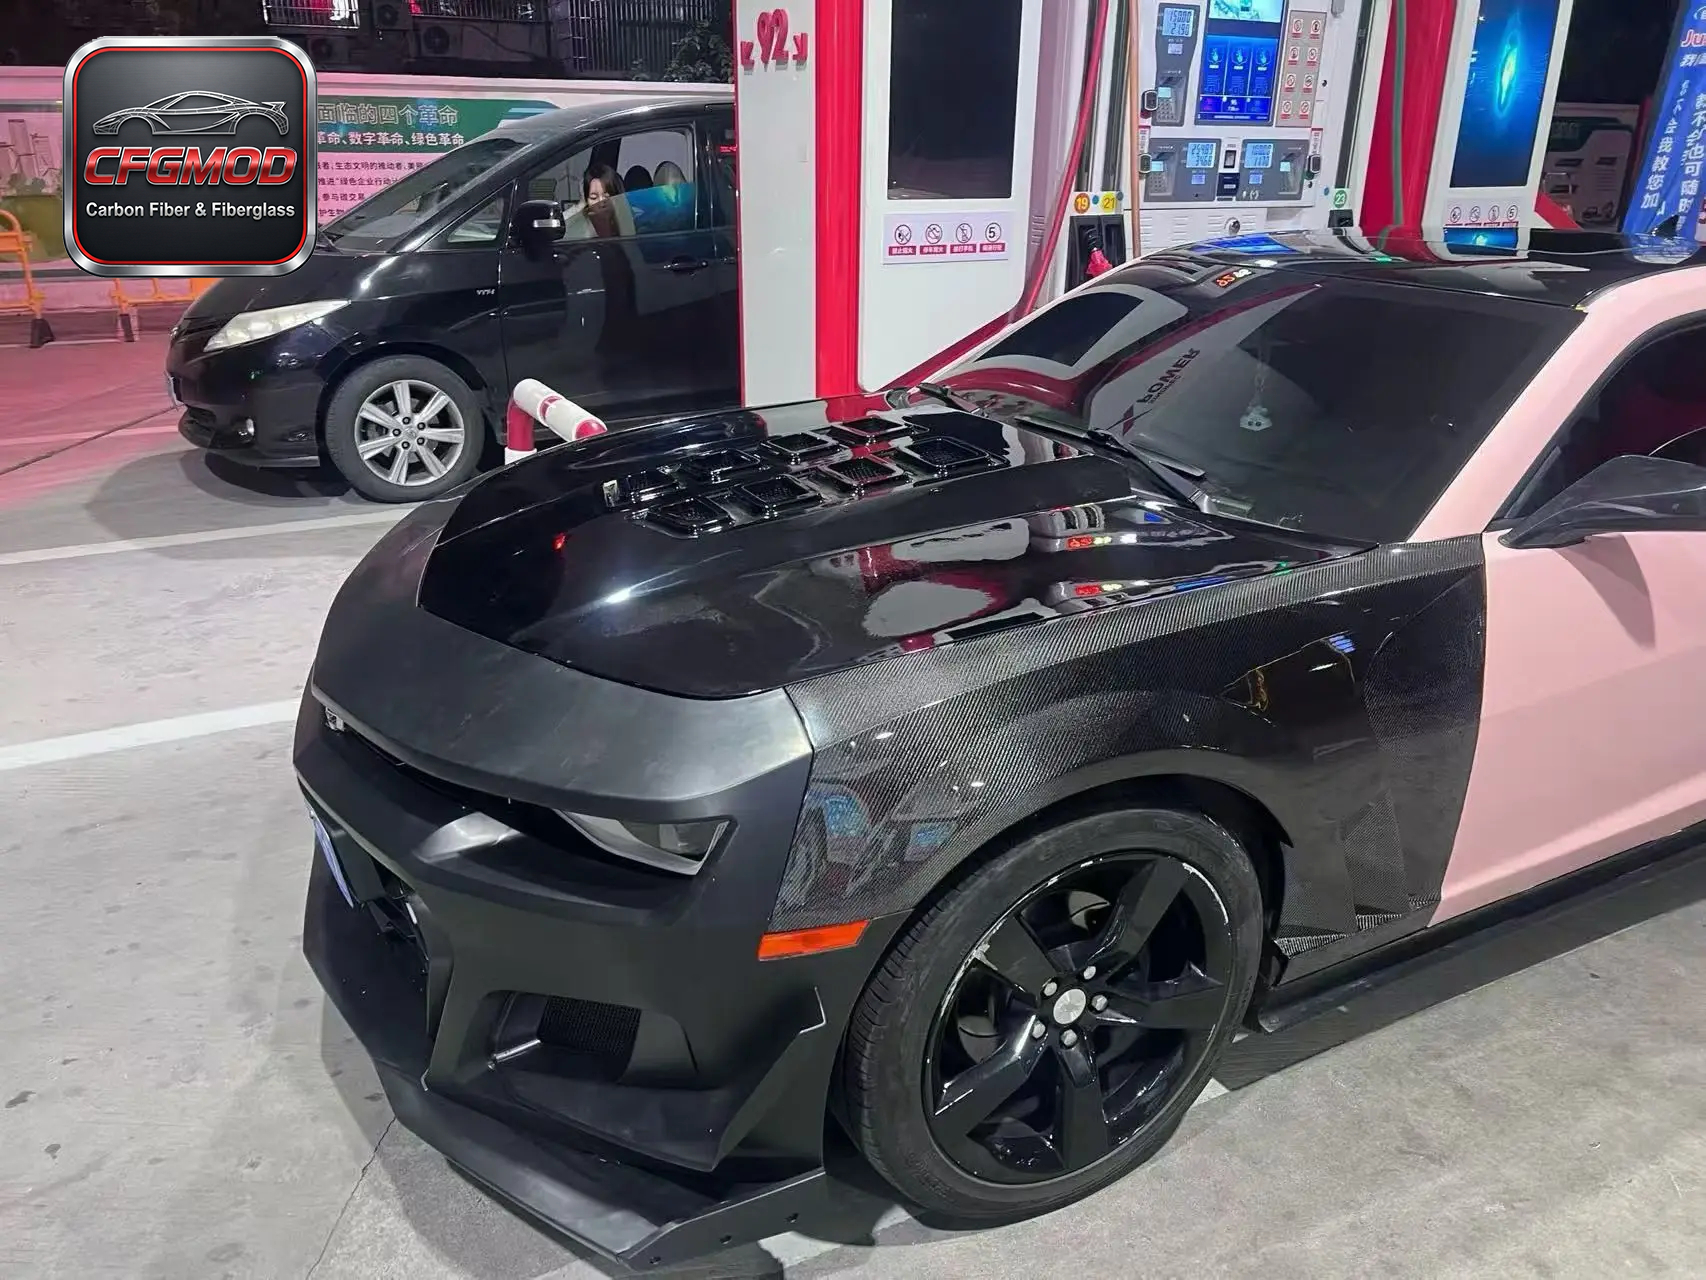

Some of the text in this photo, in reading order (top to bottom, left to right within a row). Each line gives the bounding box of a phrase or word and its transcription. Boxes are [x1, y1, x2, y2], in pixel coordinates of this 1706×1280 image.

[757, 9, 789, 65] 92
[318, 103, 458, 126] 面临的四个革命
[1077, 197, 1089, 210] 19
[1104, 197, 1115, 209] 21
[988, 227, 996, 239] 5
